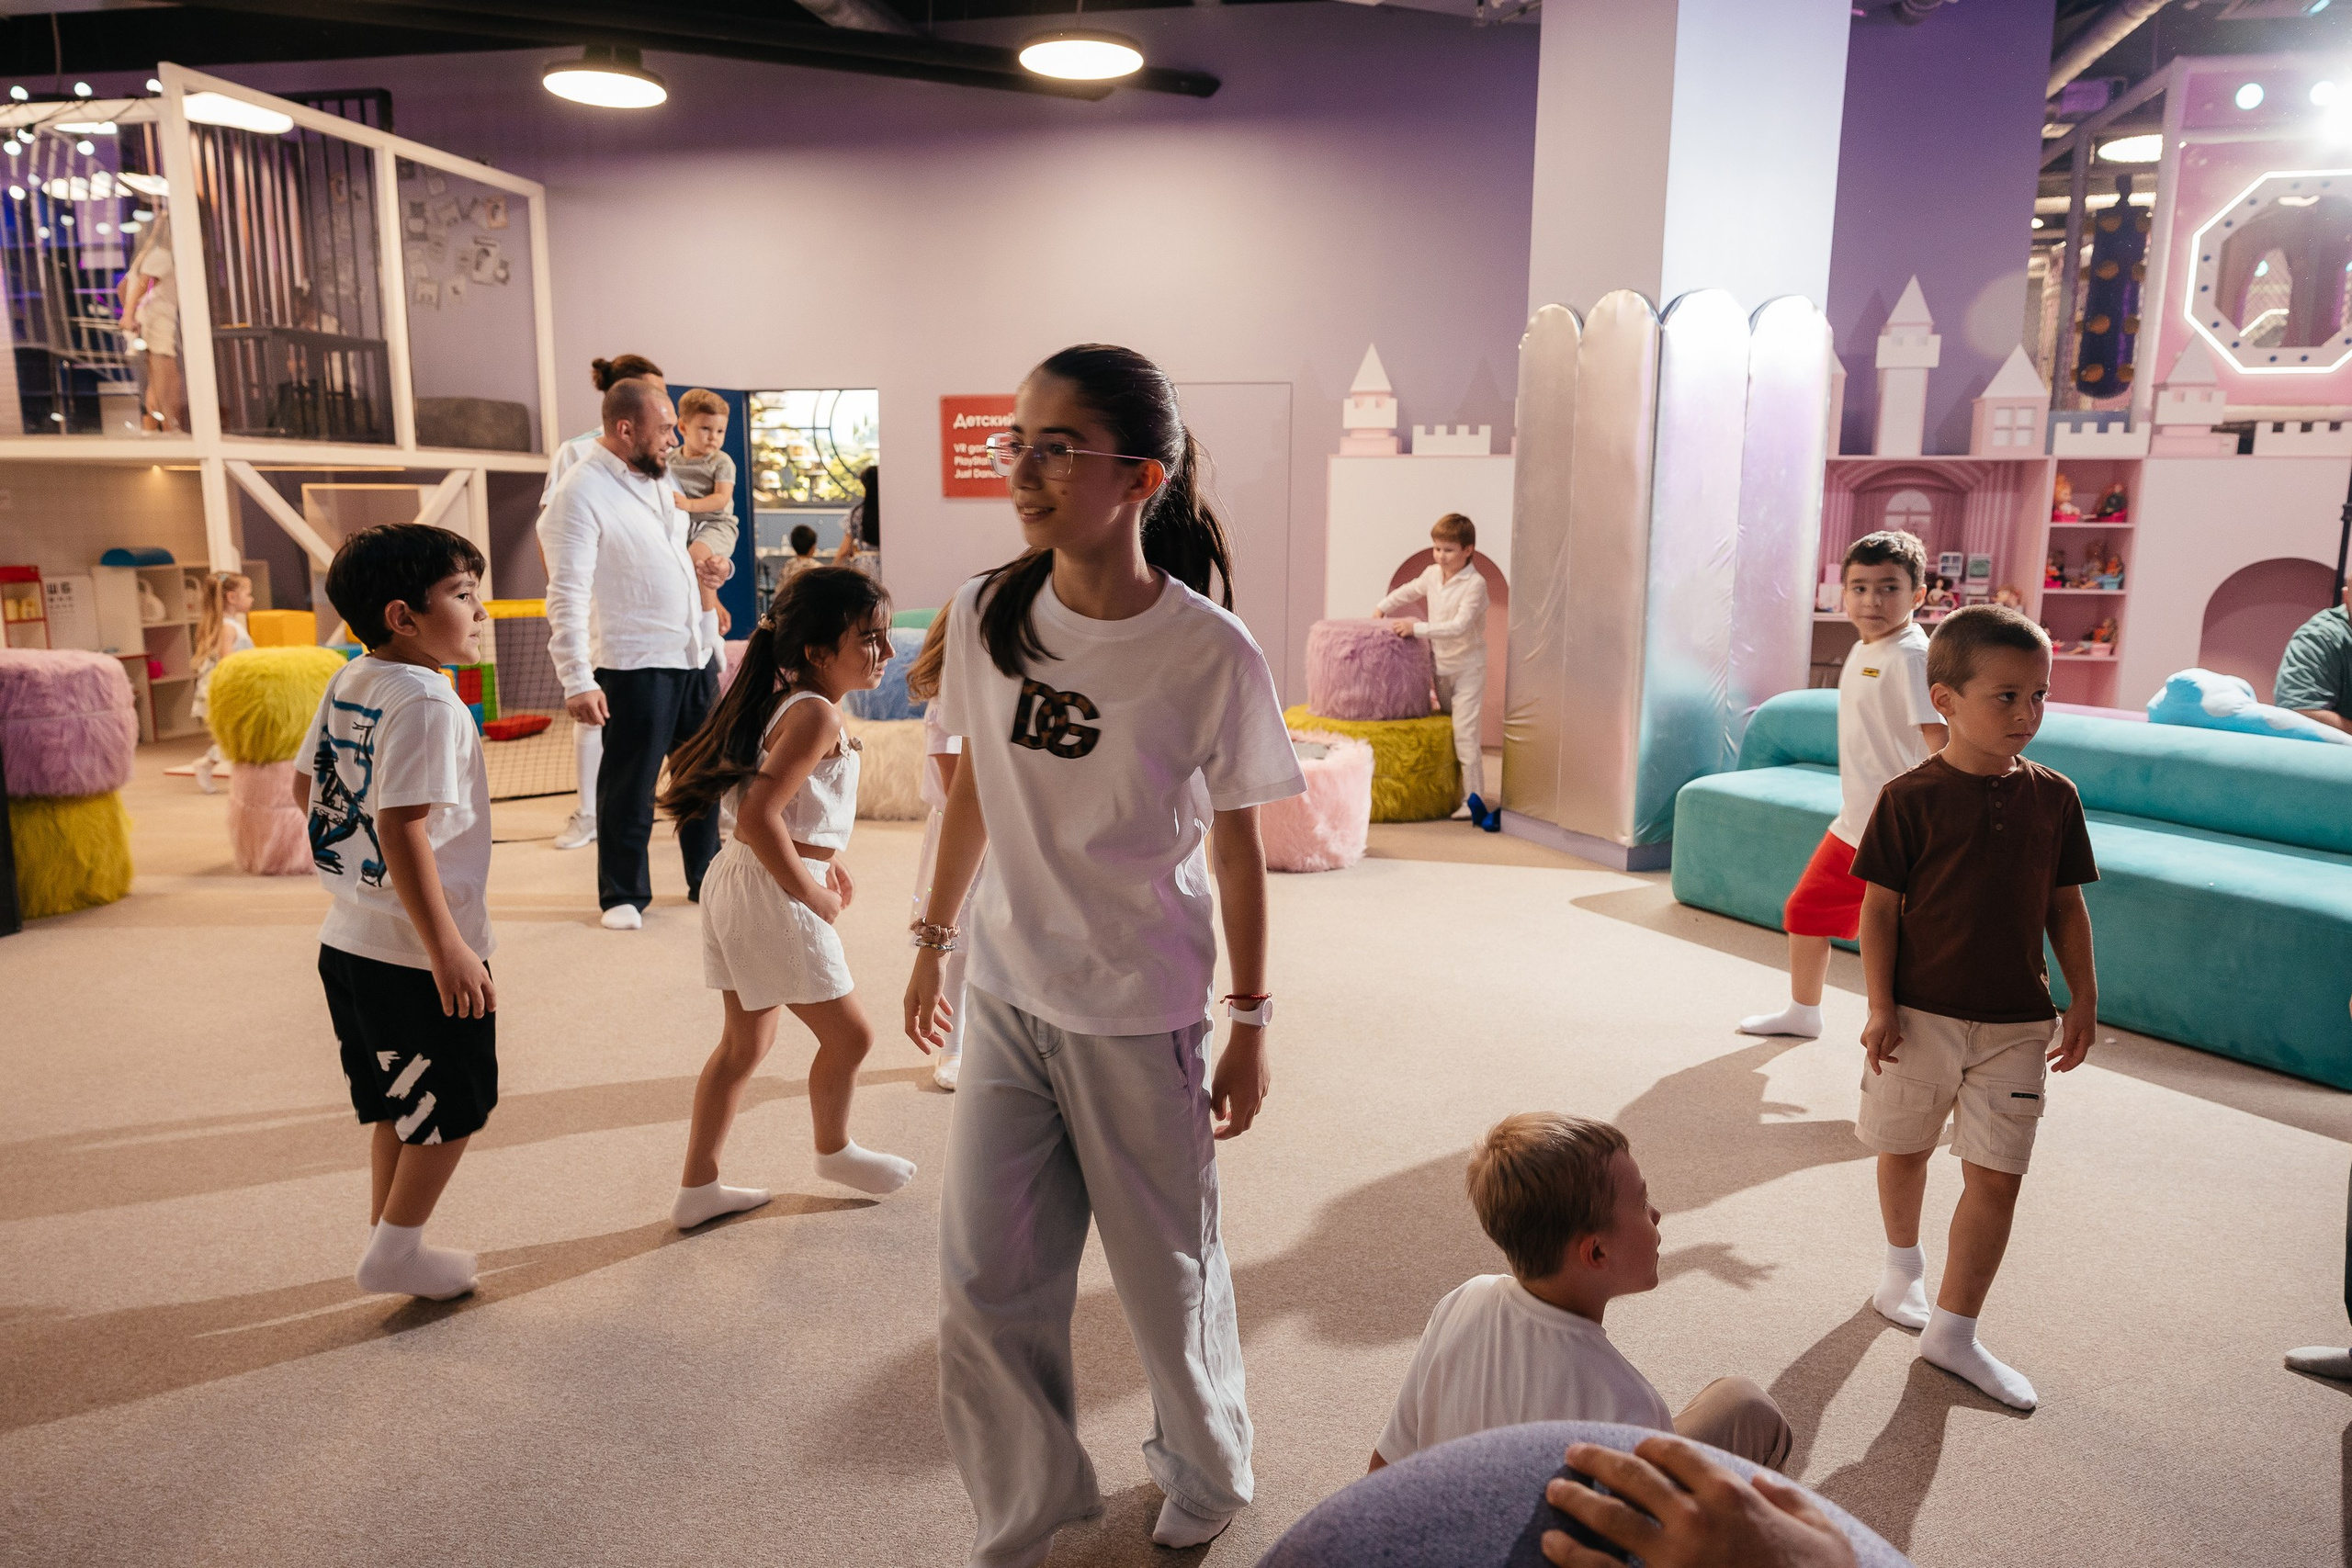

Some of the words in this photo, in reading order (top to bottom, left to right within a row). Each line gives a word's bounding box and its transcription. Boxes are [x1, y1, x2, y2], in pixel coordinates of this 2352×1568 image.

[953, 412, 1015, 429] Детский
[953, 443, 967, 454] VR
[1011, 677, 1101, 759] DG
